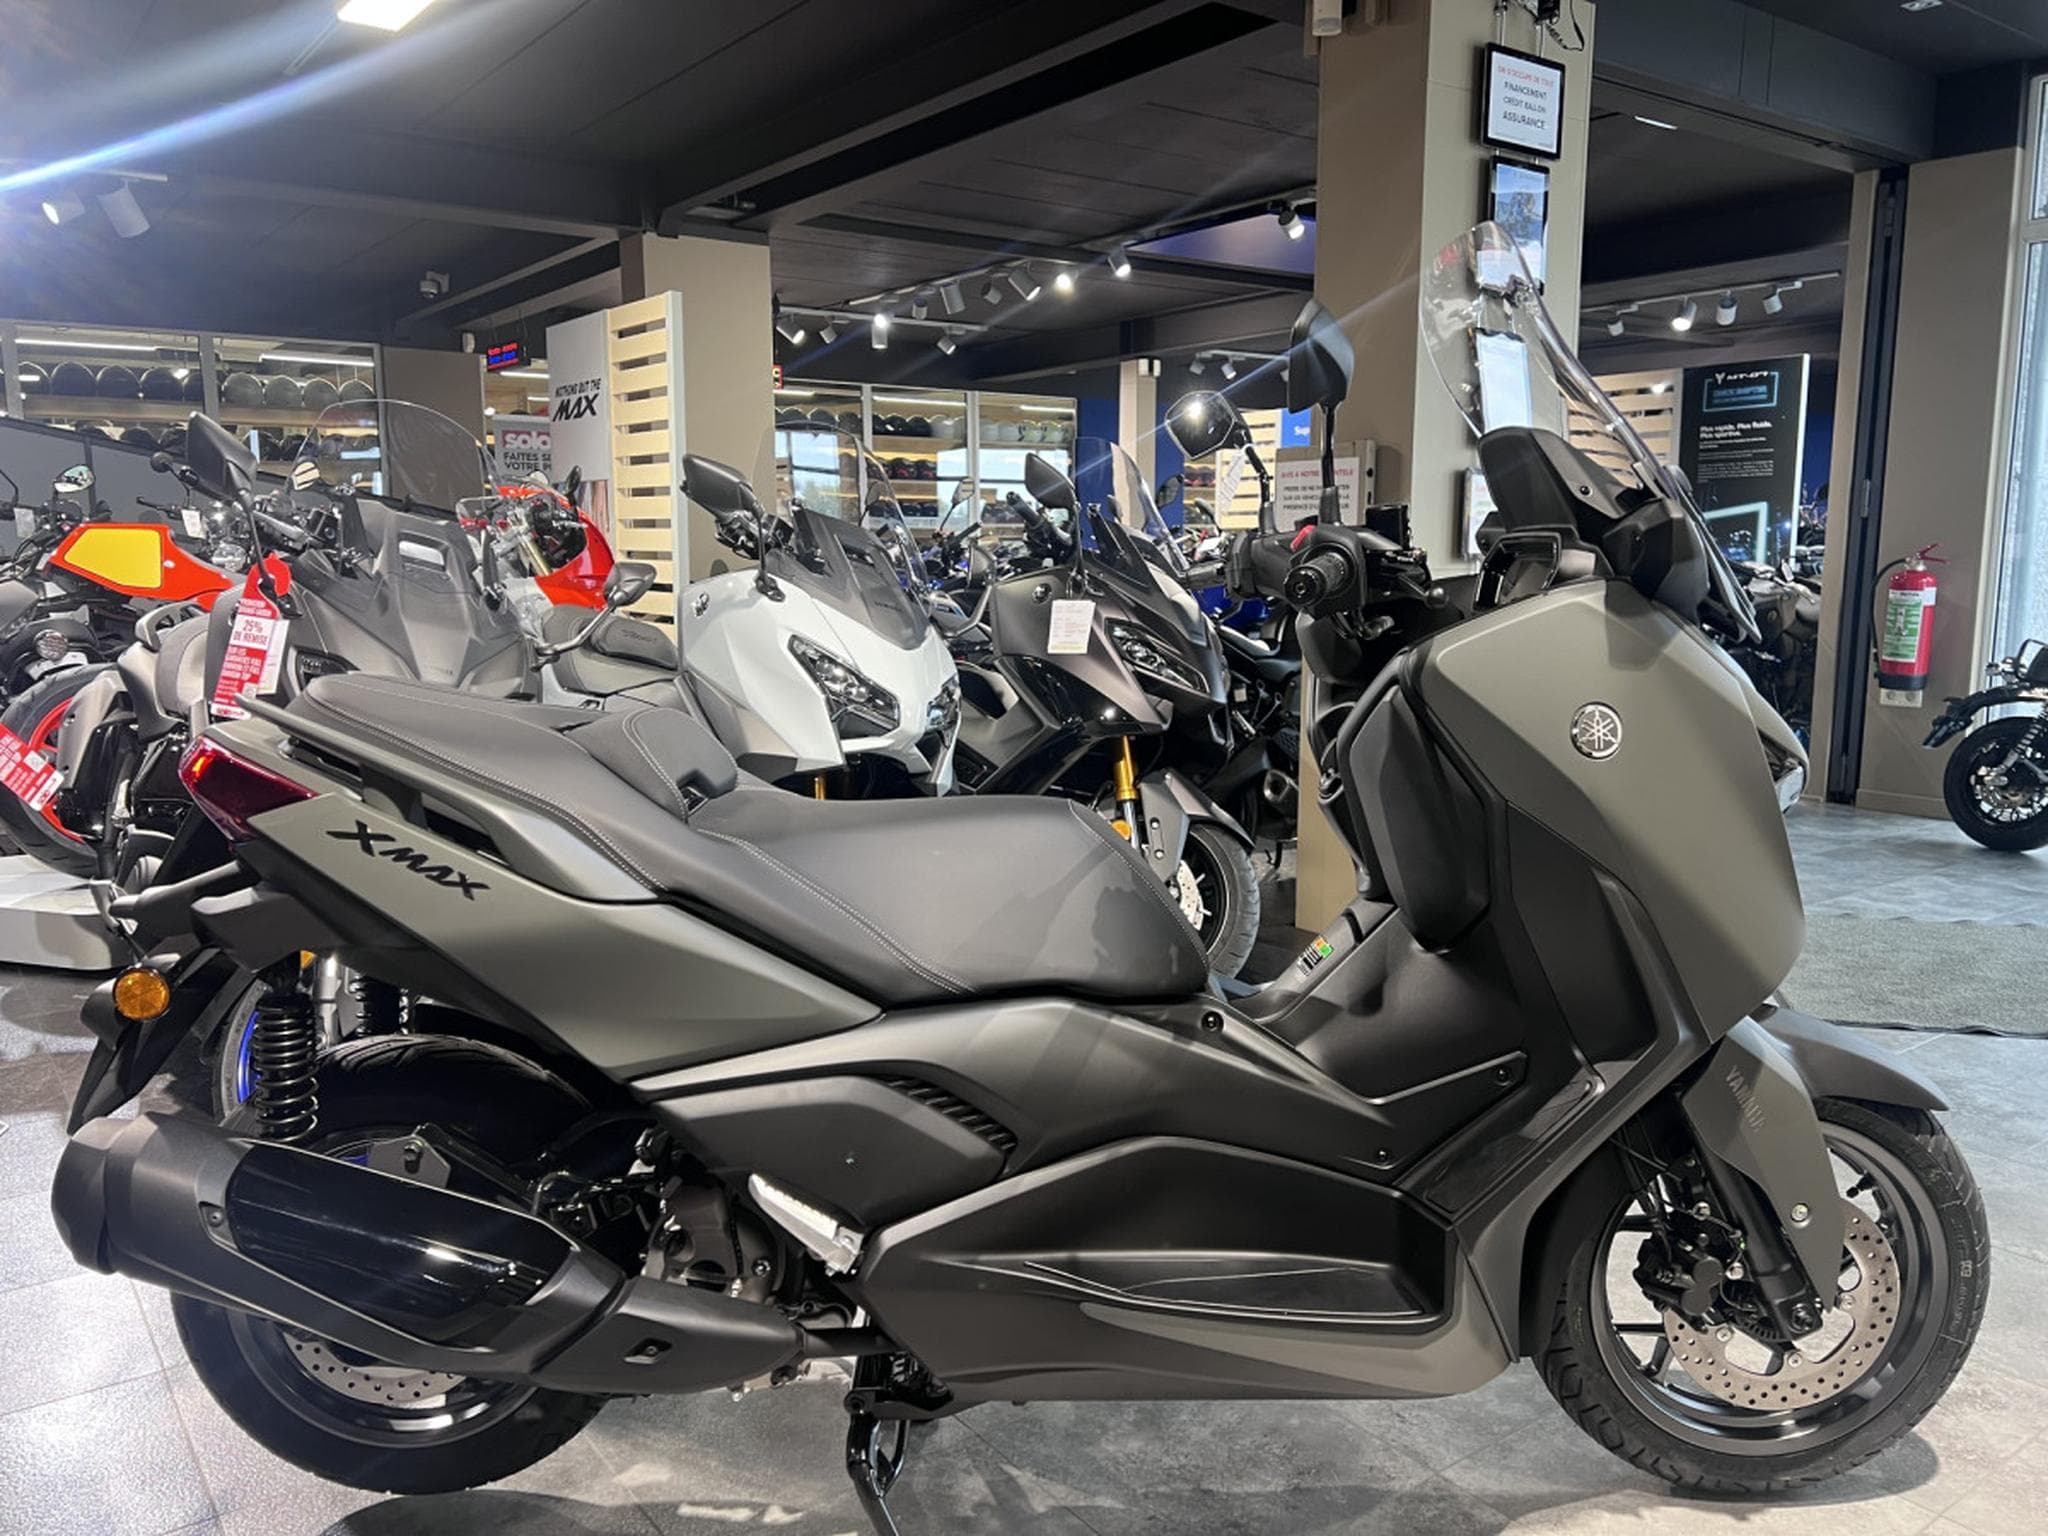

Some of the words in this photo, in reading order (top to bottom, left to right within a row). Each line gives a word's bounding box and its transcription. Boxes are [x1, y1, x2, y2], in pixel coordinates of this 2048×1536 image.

[1504, 81, 1547, 99] FINANCEMENT
[1502, 110, 1546, 130] ASSURANCE
[555, 384, 578, 397] NOTHING
[590, 378, 602, 391] THE
[552, 392, 599, 422] MAX
[503, 452, 538, 461] FAITES
[504, 462, 539, 471] VOTRE
